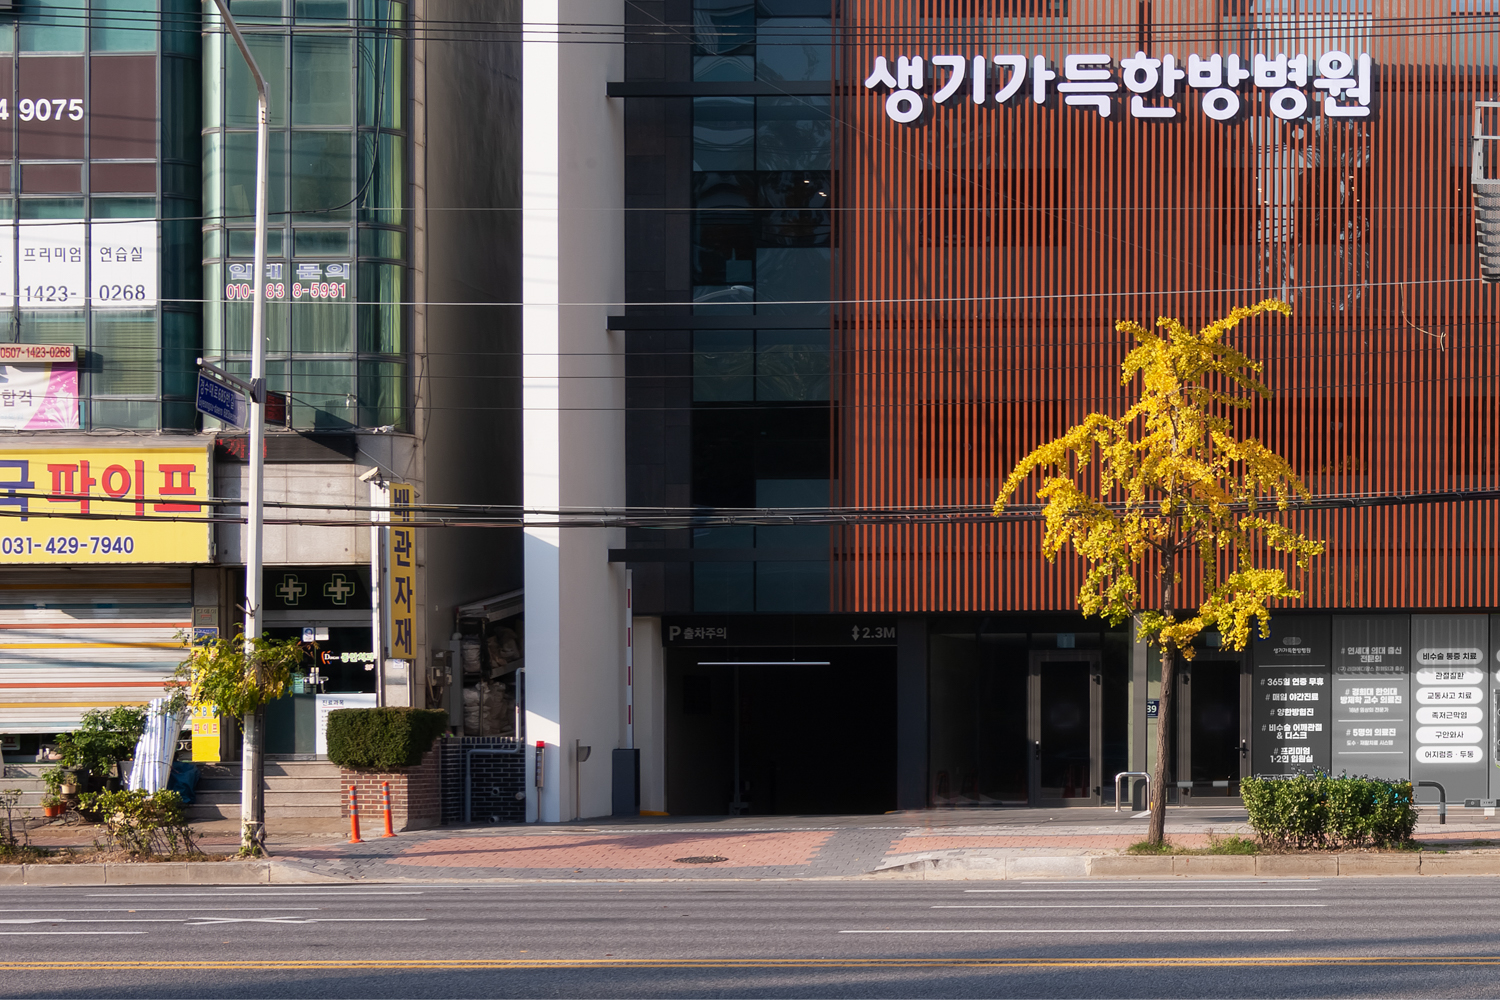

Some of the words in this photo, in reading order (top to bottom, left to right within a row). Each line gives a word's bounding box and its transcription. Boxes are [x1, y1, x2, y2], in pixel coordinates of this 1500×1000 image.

[865, 50, 1372, 123] 생기가득한방병원
[19, 98, 84, 121] 9075
[24, 247, 81, 262] 프리미엄
[100, 247, 142, 262] 연습실
[296, 263, 350, 280] 문의
[99, 285, 145, 301] 0268
[0, 347, 71, 358] 0507-1423-0268
[2, 389, 32, 407] 합격
[47, 460, 201, 516] 파이프
[2, 537, 134, 554] 031-429-7940
[394, 488, 413, 656] 배관자재
[683, 627, 727, 639] 출차주의
[862, 627, 896, 639] 2.3M
[1347, 647, 1370, 655] 연세대
[1371, 647, 1386, 655] 의대
[1360, 655, 1382, 663] 전문의
[1435, 672, 1464, 680] 관절질환
[1267, 678, 1290, 686] 365일
[1292, 678, 1307, 686] 연중
[1272, 693, 1287, 701] 매일
[1289, 693, 1319, 701] 야간진료
[1363, 696, 1378, 704] 교수
[1380, 695, 1402, 704] 의료진
[1276, 708, 1314, 716] 양한방협진
[1432, 711, 1467, 719] 족저근막염
[1269, 723, 1291, 731] 비수술
[1285, 731, 1307, 739] 디스크
[1374, 728, 1396, 736] 의료진
[1435, 731, 1464, 739] 구안와사
[1281, 747, 1310, 755] 프리미엄
[1291, 755, 1313, 763] 입원실
